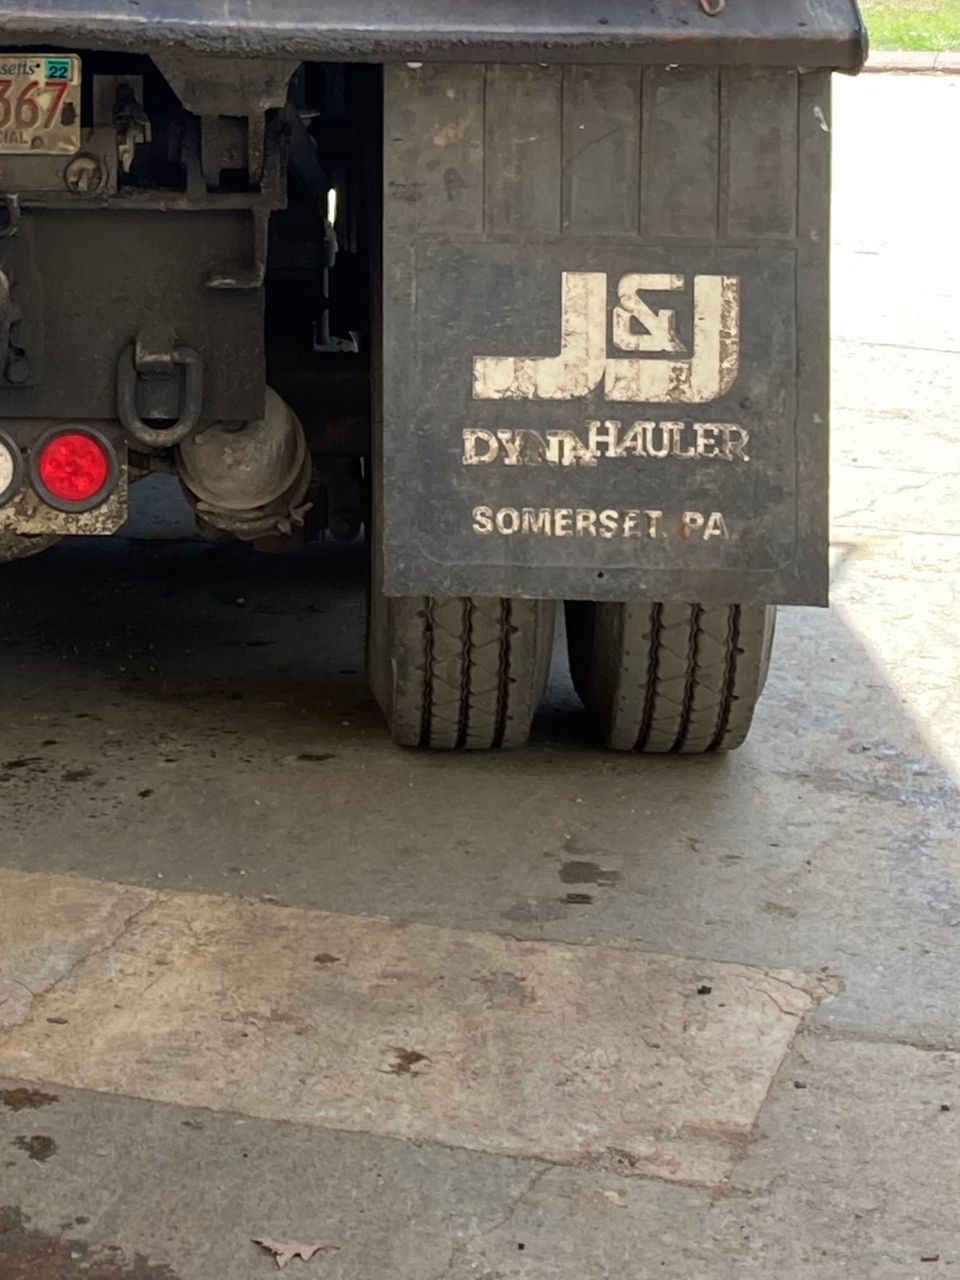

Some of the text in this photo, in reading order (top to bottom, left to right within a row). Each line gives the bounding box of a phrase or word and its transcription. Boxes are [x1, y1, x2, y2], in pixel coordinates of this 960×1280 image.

[48, 65, 69, 79] 22
[472, 271, 741, 404] J&J
[682, 510, 731, 541] PA
